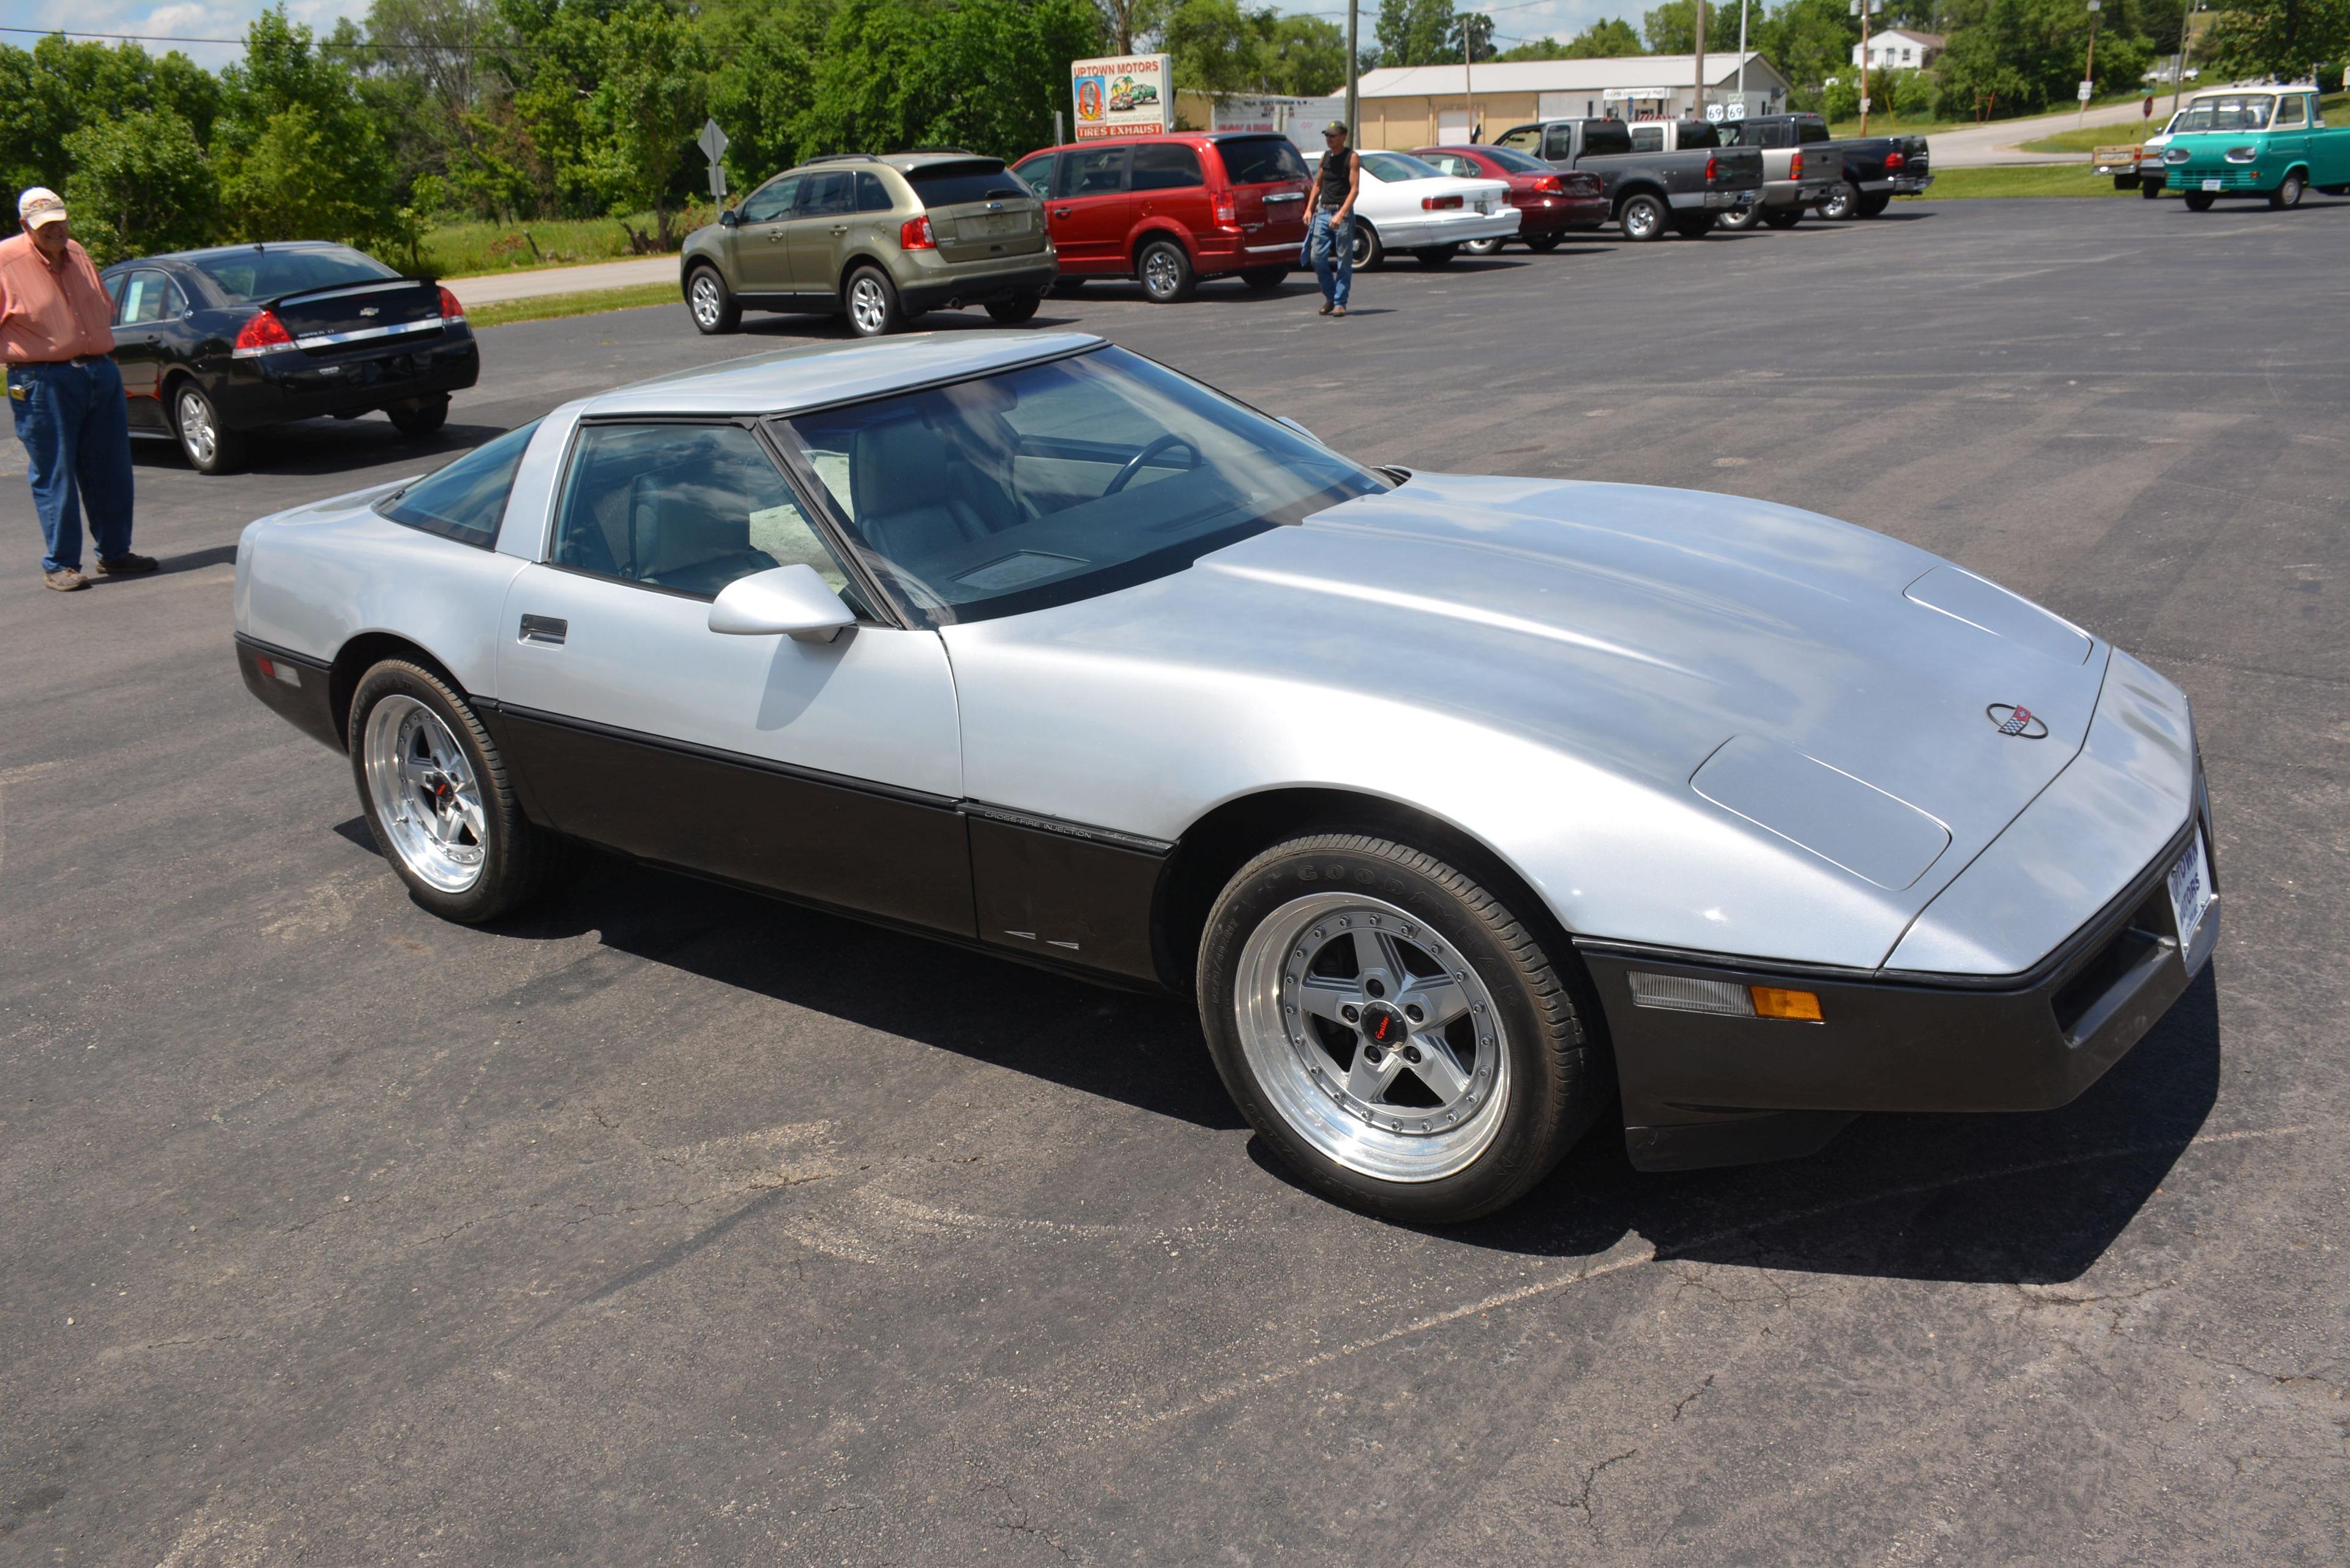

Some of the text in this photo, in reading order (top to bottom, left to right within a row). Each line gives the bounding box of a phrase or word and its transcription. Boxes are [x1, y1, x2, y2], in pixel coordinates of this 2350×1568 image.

[1074, 61, 1158, 77] UPTOWN MOTORS
[1709, 108, 1721, 119] 69
[1729, 107, 1742, 118] 69
[1078, 124, 1160, 137] TIRES EXHAUST
[984, 812, 1092, 838] CROSS-FIRE INJECTION
[2172, 841, 2198, 903] UPTOWN
[2179, 872, 2200, 930] MOTORS
[1296, 864, 1520, 1010] GOODYEAR
[1375, 1015, 1389, 1039] Epsilon
